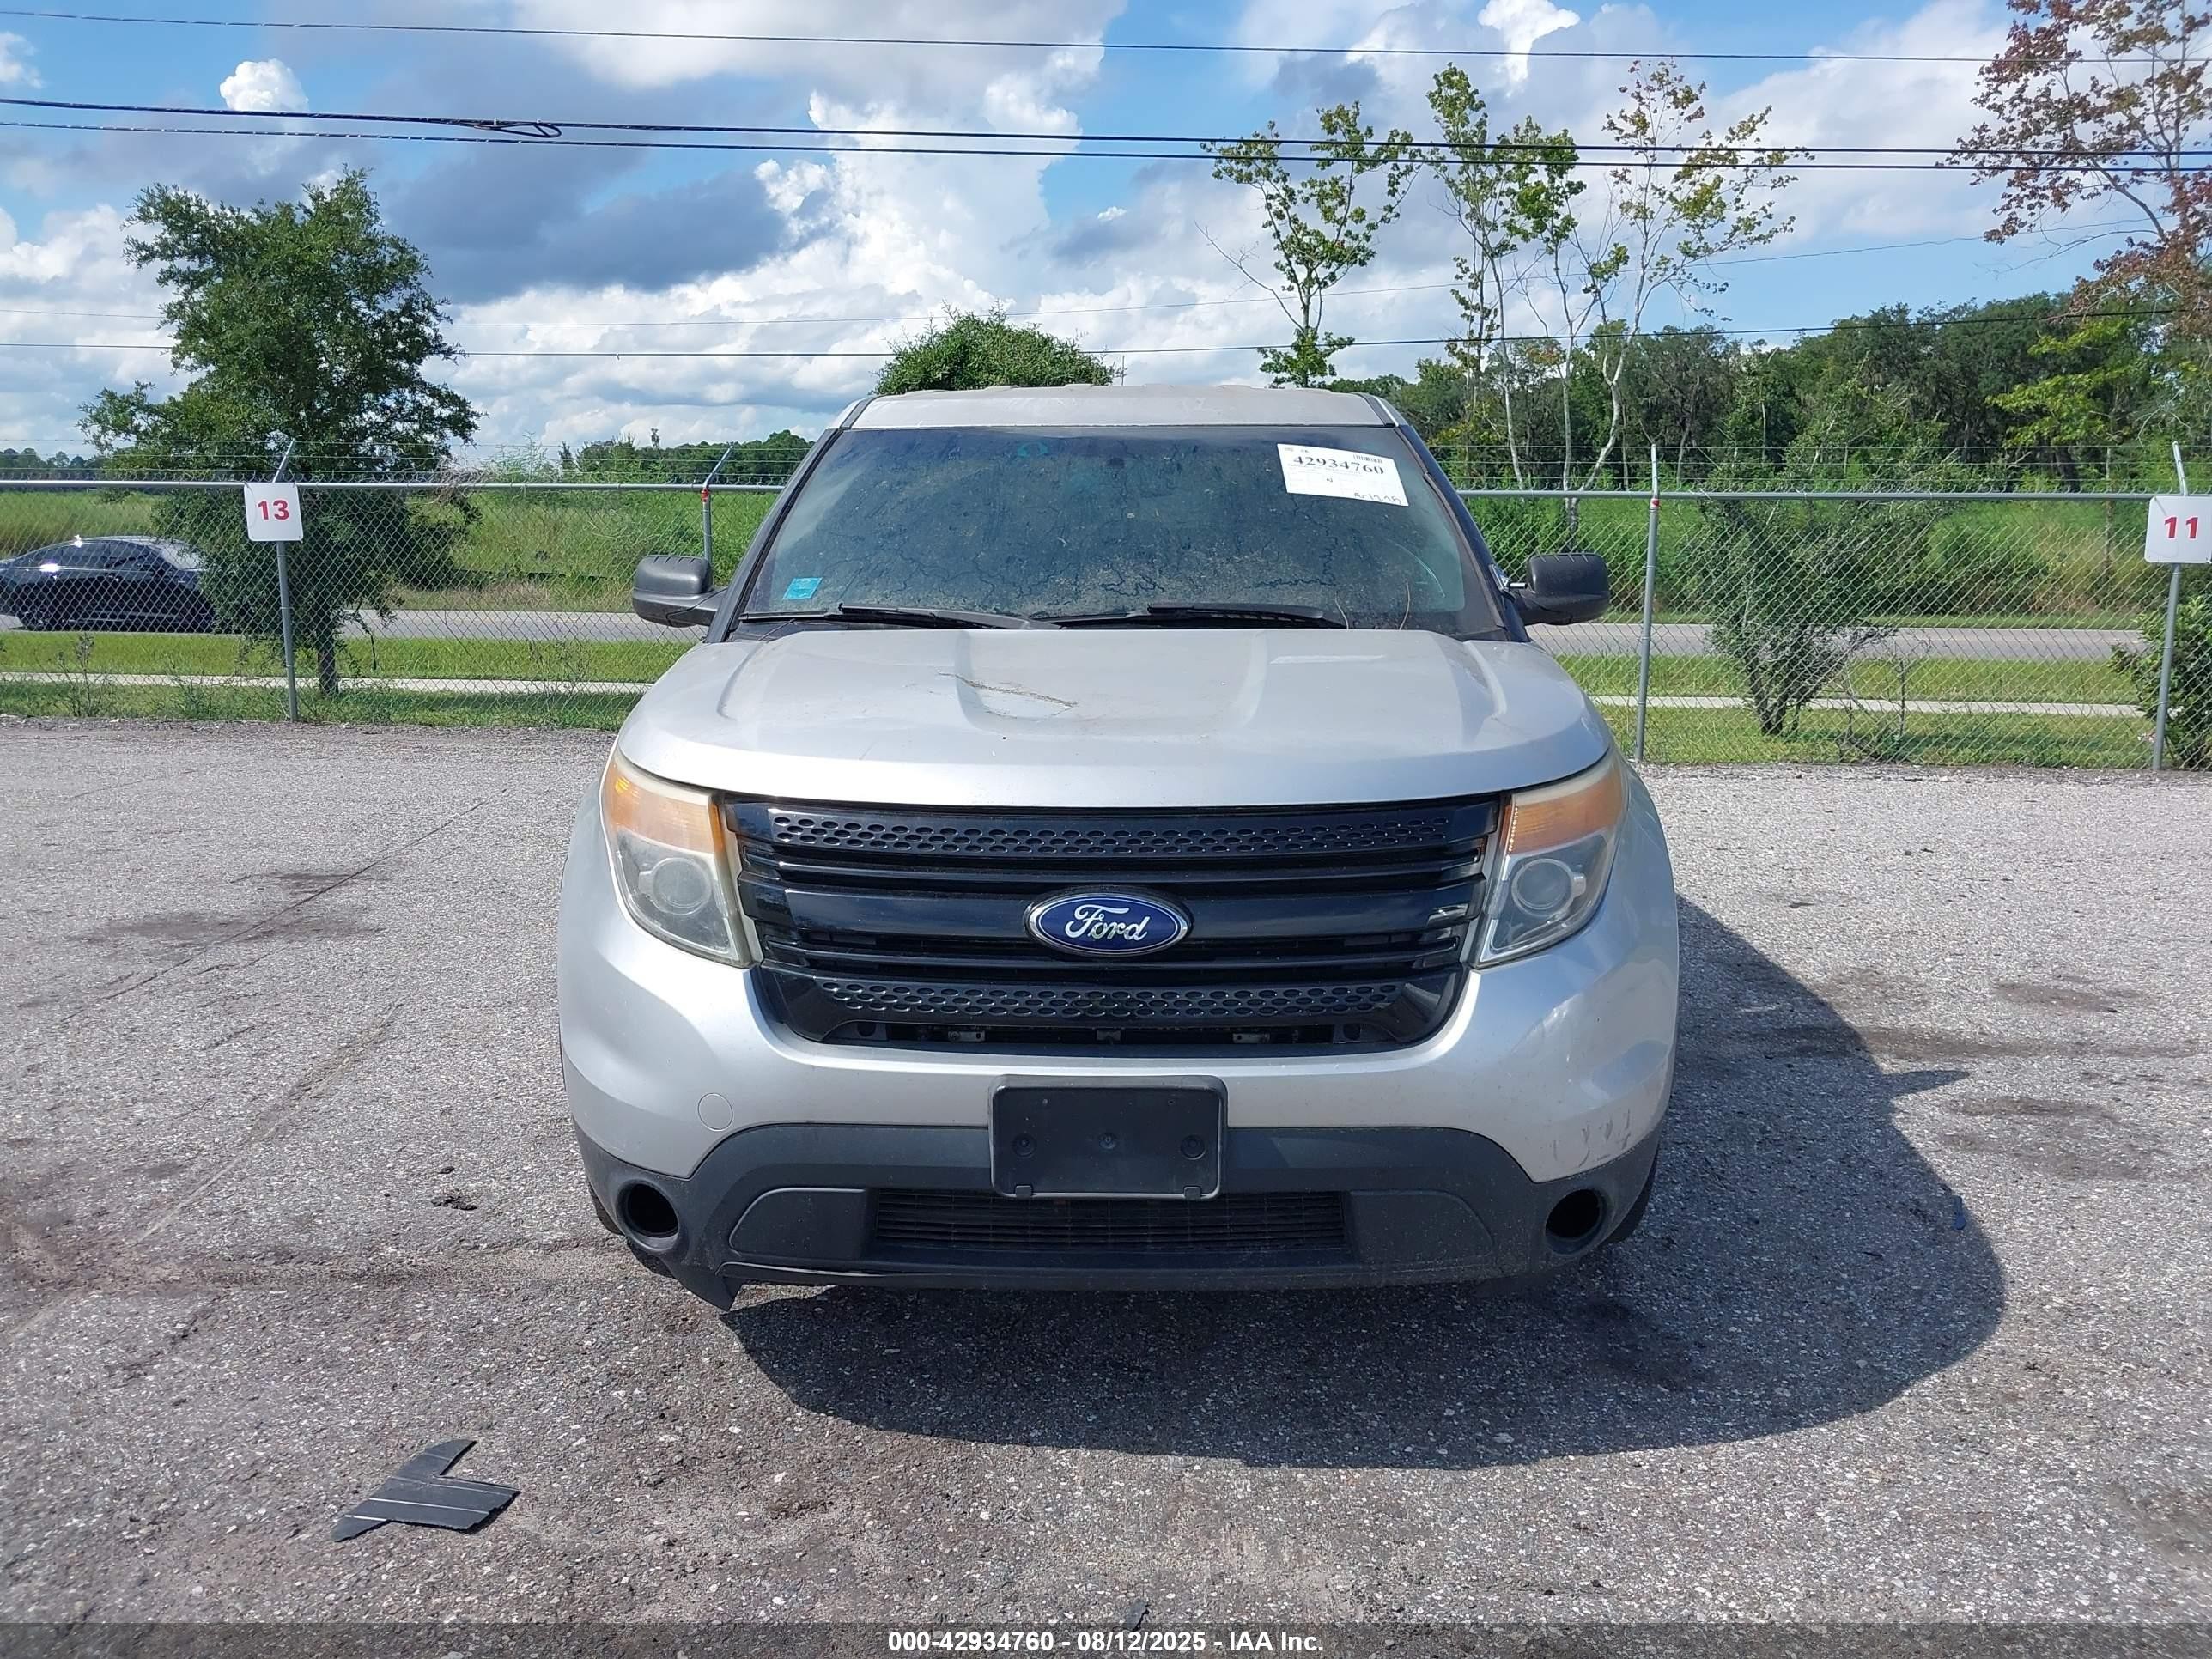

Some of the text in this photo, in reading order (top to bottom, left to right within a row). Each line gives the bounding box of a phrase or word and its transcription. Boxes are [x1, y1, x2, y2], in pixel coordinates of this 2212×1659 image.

[1293, 455, 1384, 475] 42934760
[258, 499, 289, 520] 13
[2164, 516, 2198, 539] 11
[1065, 904, 1151, 941] Ford
